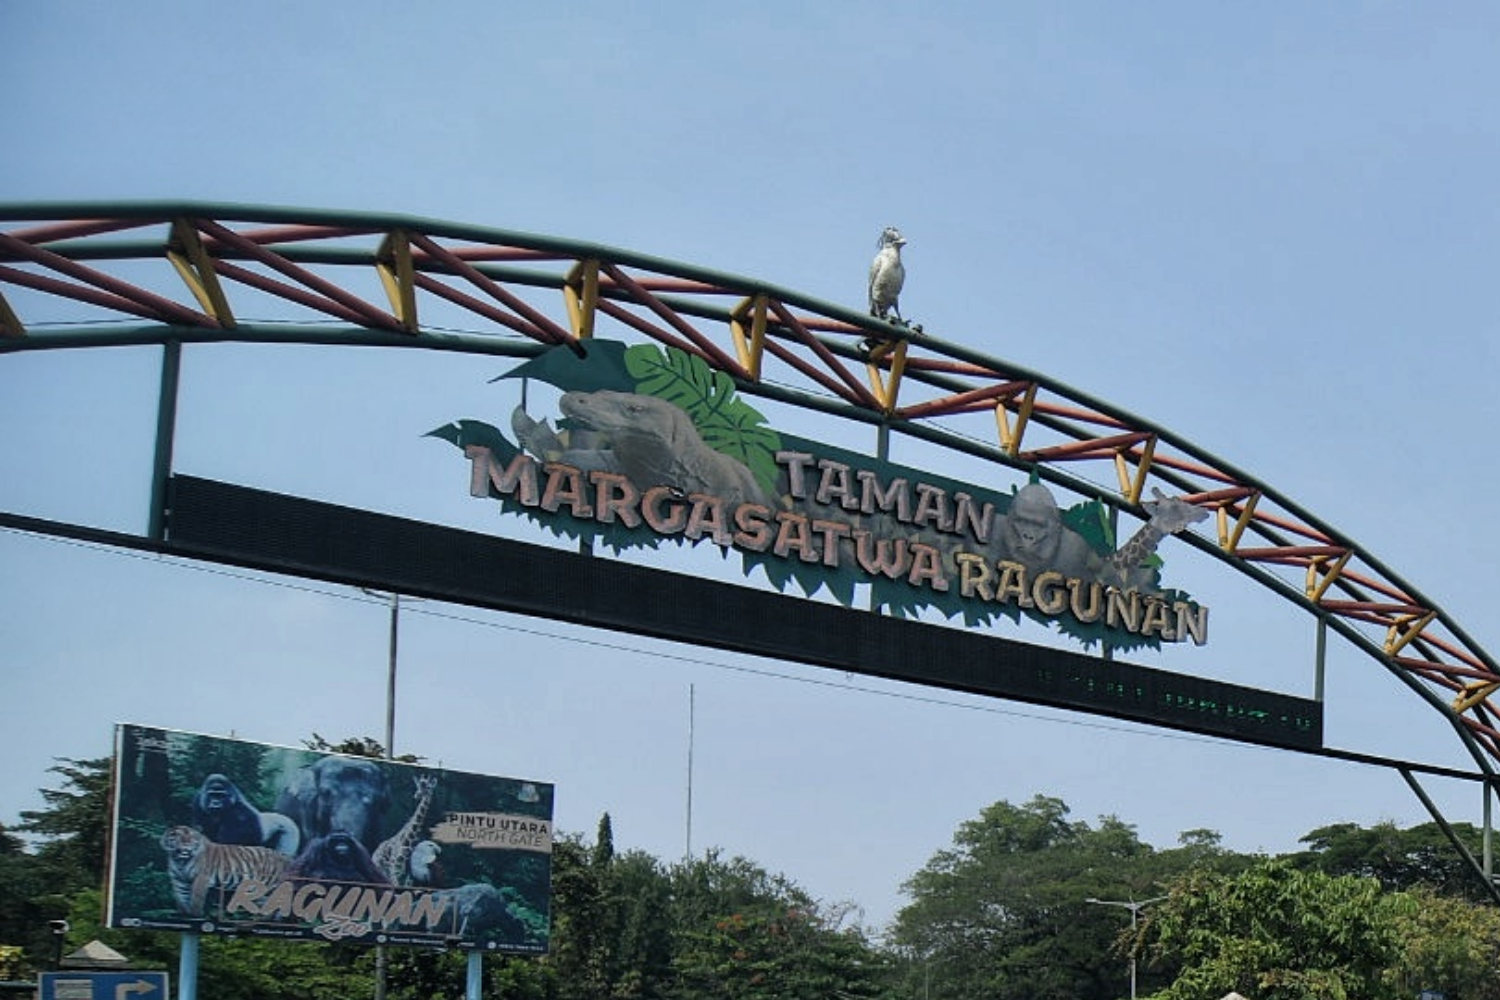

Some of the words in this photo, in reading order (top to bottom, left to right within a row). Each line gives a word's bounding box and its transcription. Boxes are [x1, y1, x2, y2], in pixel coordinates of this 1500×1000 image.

[775, 450, 995, 544] TAMAN
[465, 444, 949, 593] MARGASATWA
[956, 551, 1209, 646] RAGUNAN
[449, 814, 496, 829] PINTU
[501, 819, 548, 835] UTARA
[456, 828, 505, 843] NORTH
[508, 832, 542, 847] GATE
[227, 879, 448, 927] RAGUNAN
